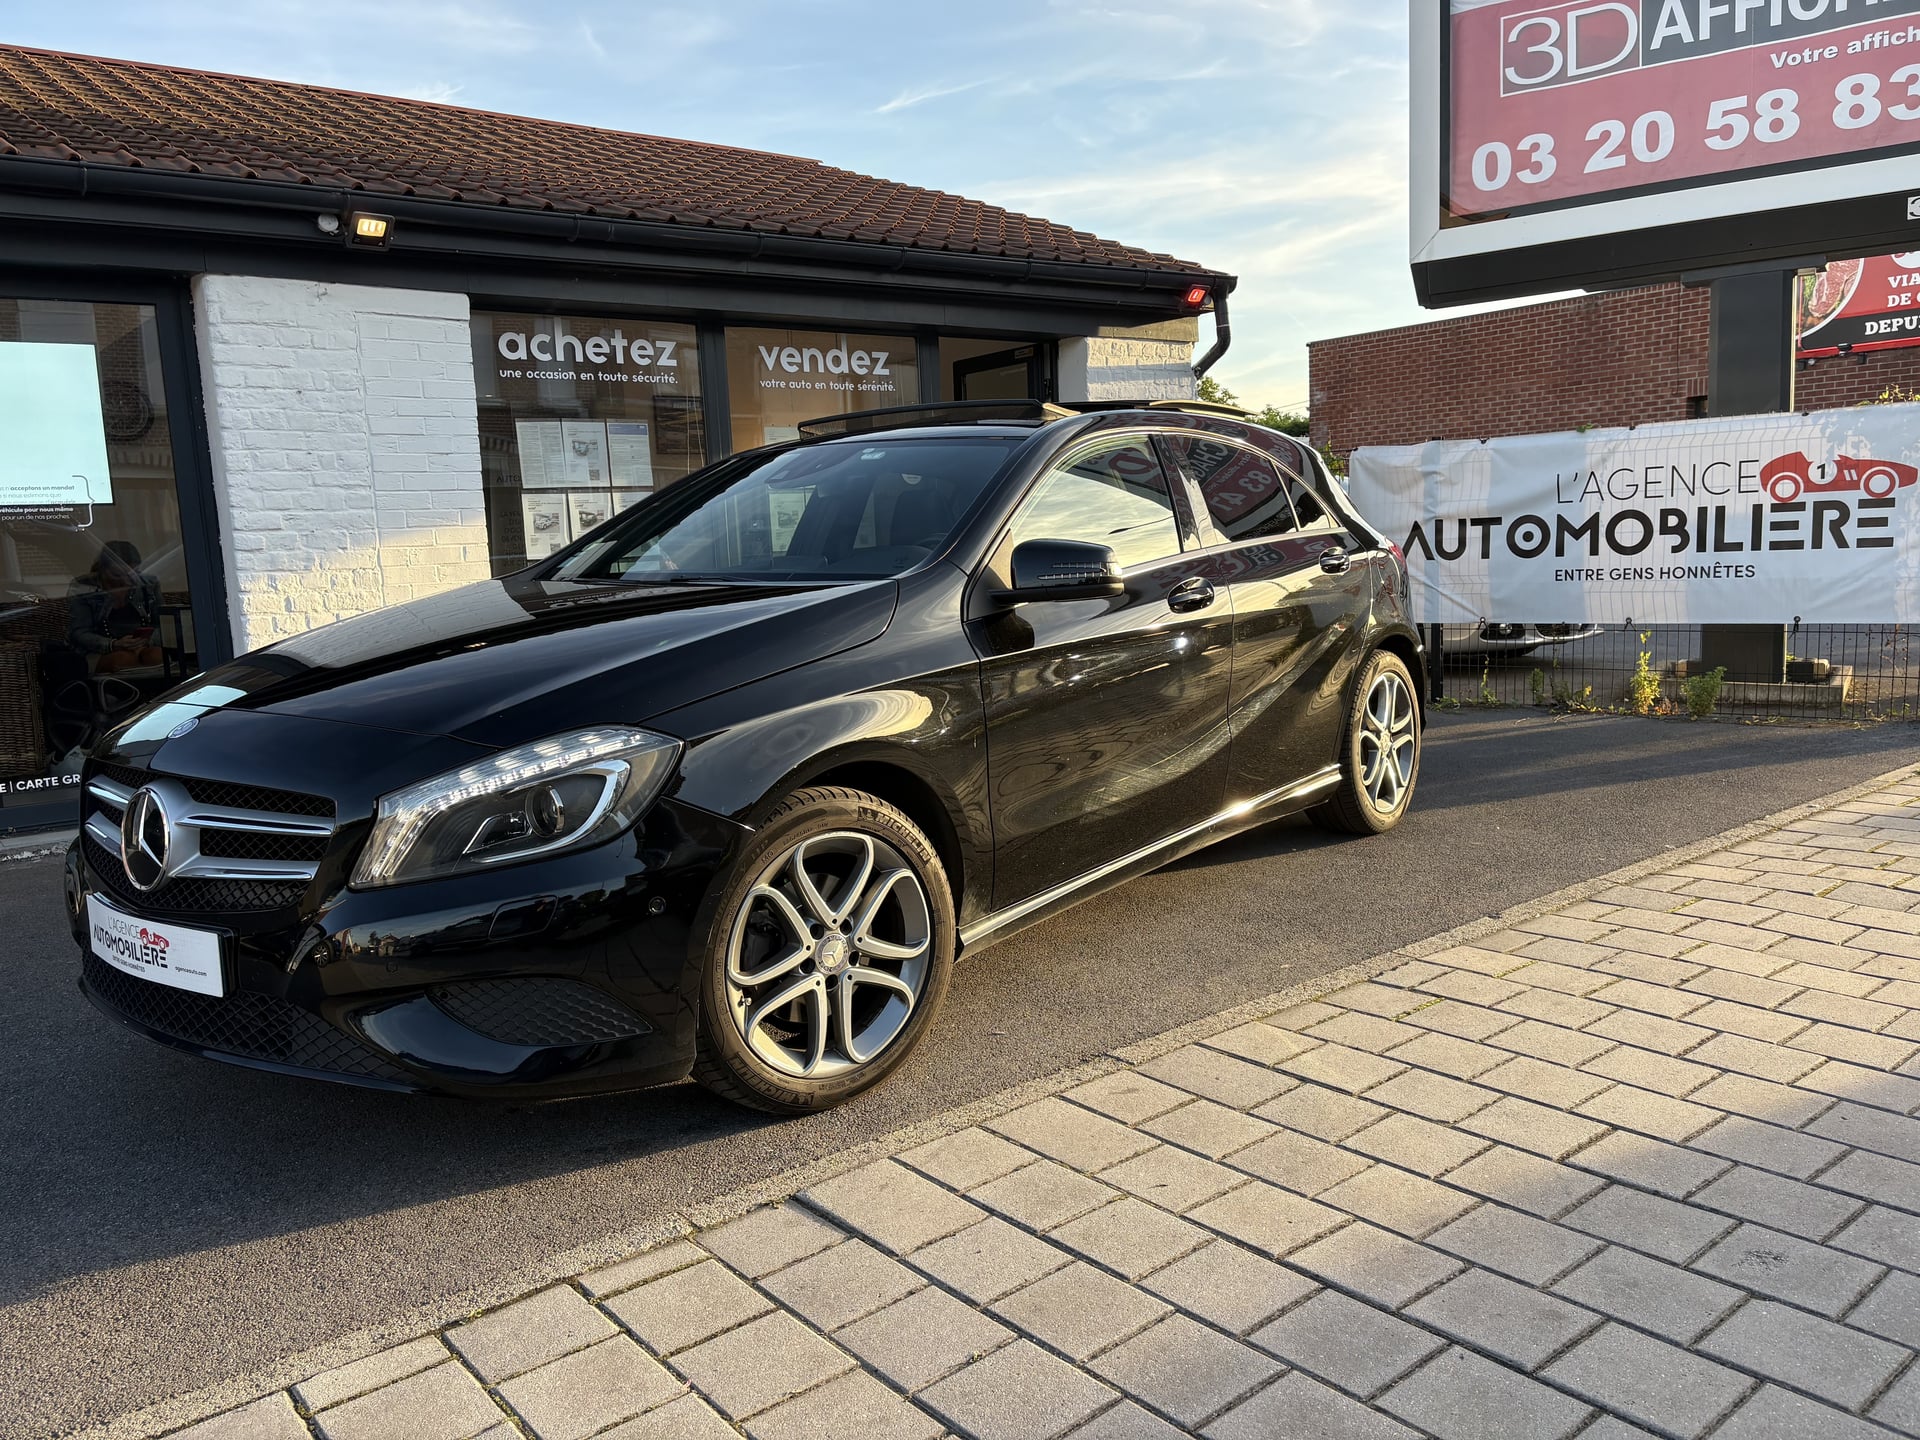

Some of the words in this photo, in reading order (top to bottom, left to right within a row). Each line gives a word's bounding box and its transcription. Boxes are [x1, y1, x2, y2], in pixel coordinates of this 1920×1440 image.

[1505, 2, 1638, 85] 3D
[1770, 45, 1838, 69] Votre
[1471, 133, 1557, 192] 03
[1584, 110, 1675, 174] 20
[1704, 88, 1800, 151] 58
[1832, 64, 1920, 130] 83
[1888, 292, 1912, 308] DE
[1865, 315, 1920, 335] DEPU
[498, 319, 678, 367] achetez
[758, 335, 890, 375] vendez
[500, 370, 522, 378] une
[526, 368, 577, 380] occasion
[580, 372, 595, 381] en
[599, 371, 629, 382] toute
[632, 371, 678, 384] sécurité.
[760, 379, 786, 388] votre
[789, 380, 812, 389] auto
[815, 382, 826, 390] en
[830, 381, 855, 391] toute
[857, 380, 896, 392] sérénité.
[1557, 459, 1760, 504] L'AGENCE
[1402, 497, 1896, 561] AUTOMOBILIERE
[1555, 568, 1604, 582] ENTRE
[1609, 567, 1654, 581] GENS
[1660, 561, 1756, 580] HONNÊTES
[16, 776, 60, 791] CARTE
[875, 811, 932, 862] MICHELIN
